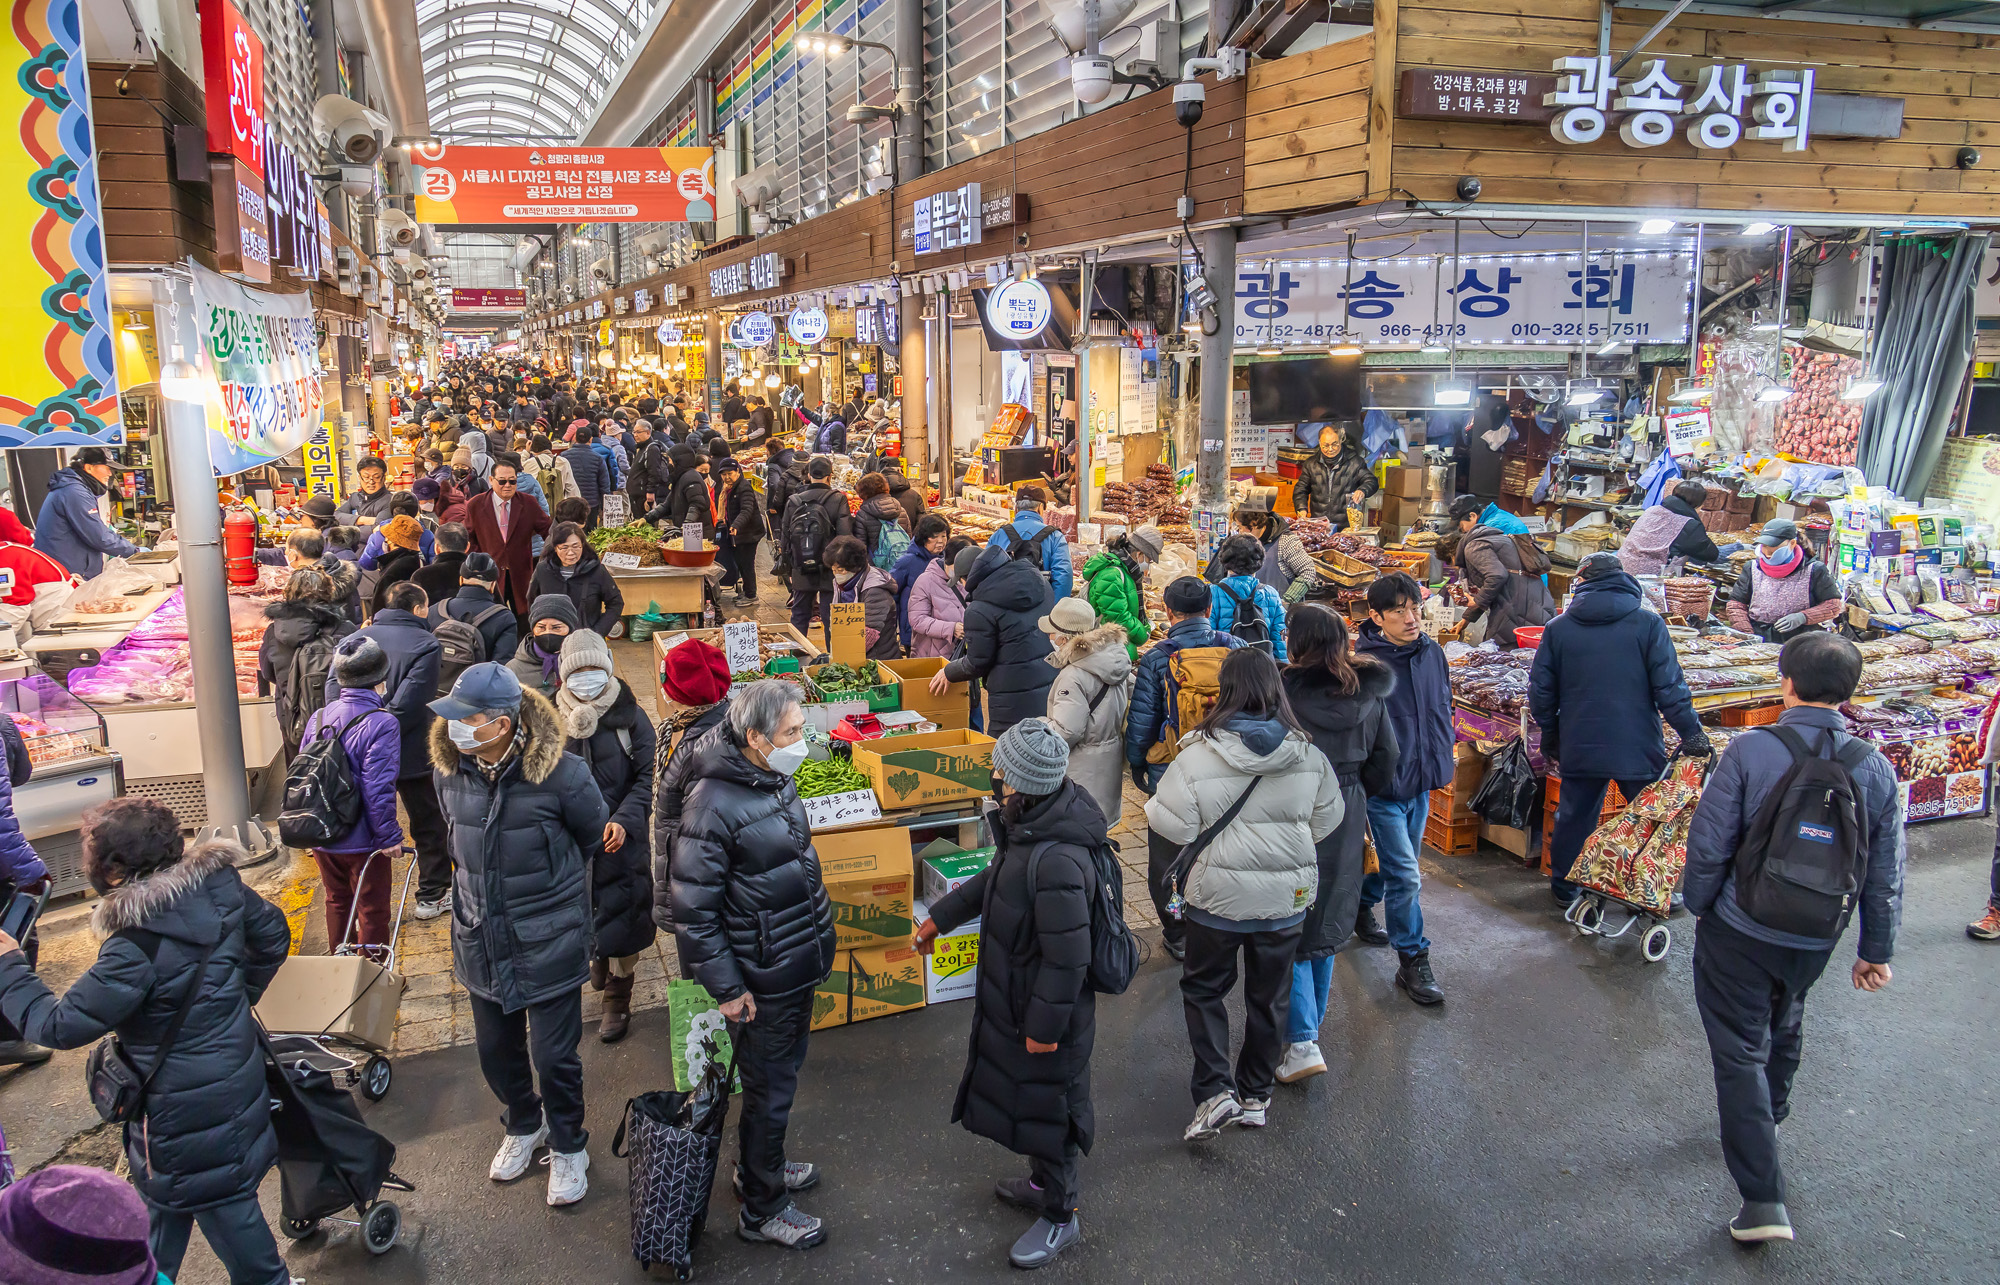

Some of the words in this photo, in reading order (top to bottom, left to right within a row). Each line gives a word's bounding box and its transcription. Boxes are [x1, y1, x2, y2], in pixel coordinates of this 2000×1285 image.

[1508, 79, 1528, 95] 일체
[1543, 55, 1815, 151] 광송상회
[251, 109, 263, 169] 우아
[547, 154, 571, 165] 청량리
[573, 154, 605, 165] 종합시장
[462, 169, 504, 184] 서울시
[508, 170, 551, 184] 디자인
[555, 170, 582, 184] 혁신
[586, 170, 640, 184] 전통시장
[645, 170, 671, 183] 조성
[683, 173, 703, 195] 축
[427, 174, 451, 195] 경
[526, 185, 581, 199] 공모사업
[585, 185, 613, 199] 선정
[265, 123, 319, 281] 우아농장
[546, 207, 576, 216] 시장으로
[797, 317, 821, 327] 하나김
[1511, 322, 1649, 336] 010-3285-7511
[1380, 324, 1466, 337] 966-4873
[738, 636, 758, 651] 청양
[1799, 825, 1833, 839] JANSPORT
[934, 952, 979, 969] 오이고
